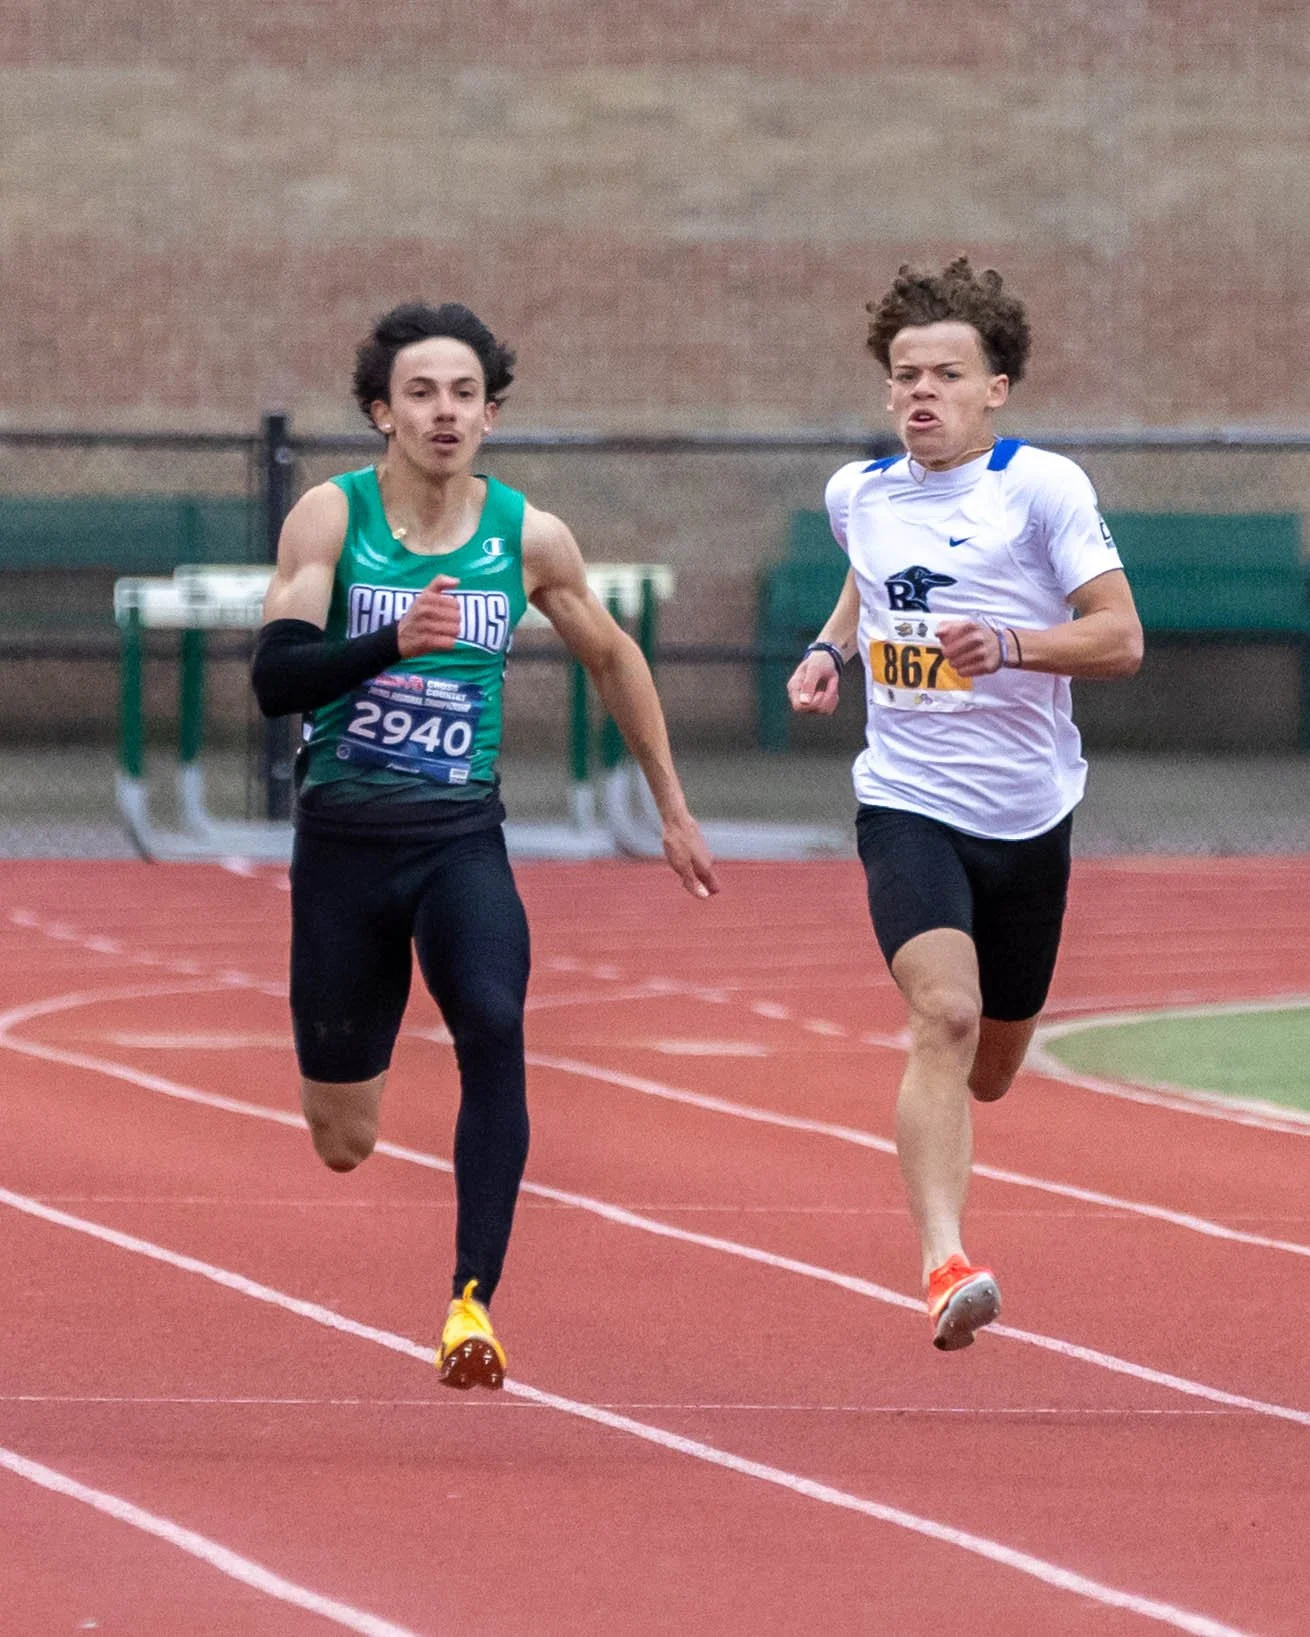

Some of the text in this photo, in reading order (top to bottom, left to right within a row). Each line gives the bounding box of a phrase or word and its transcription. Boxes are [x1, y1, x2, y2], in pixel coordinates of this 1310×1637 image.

[349, 586, 508, 654] CAPINS
[883, 643, 945, 689] 867
[347, 701, 472, 757] 2940
